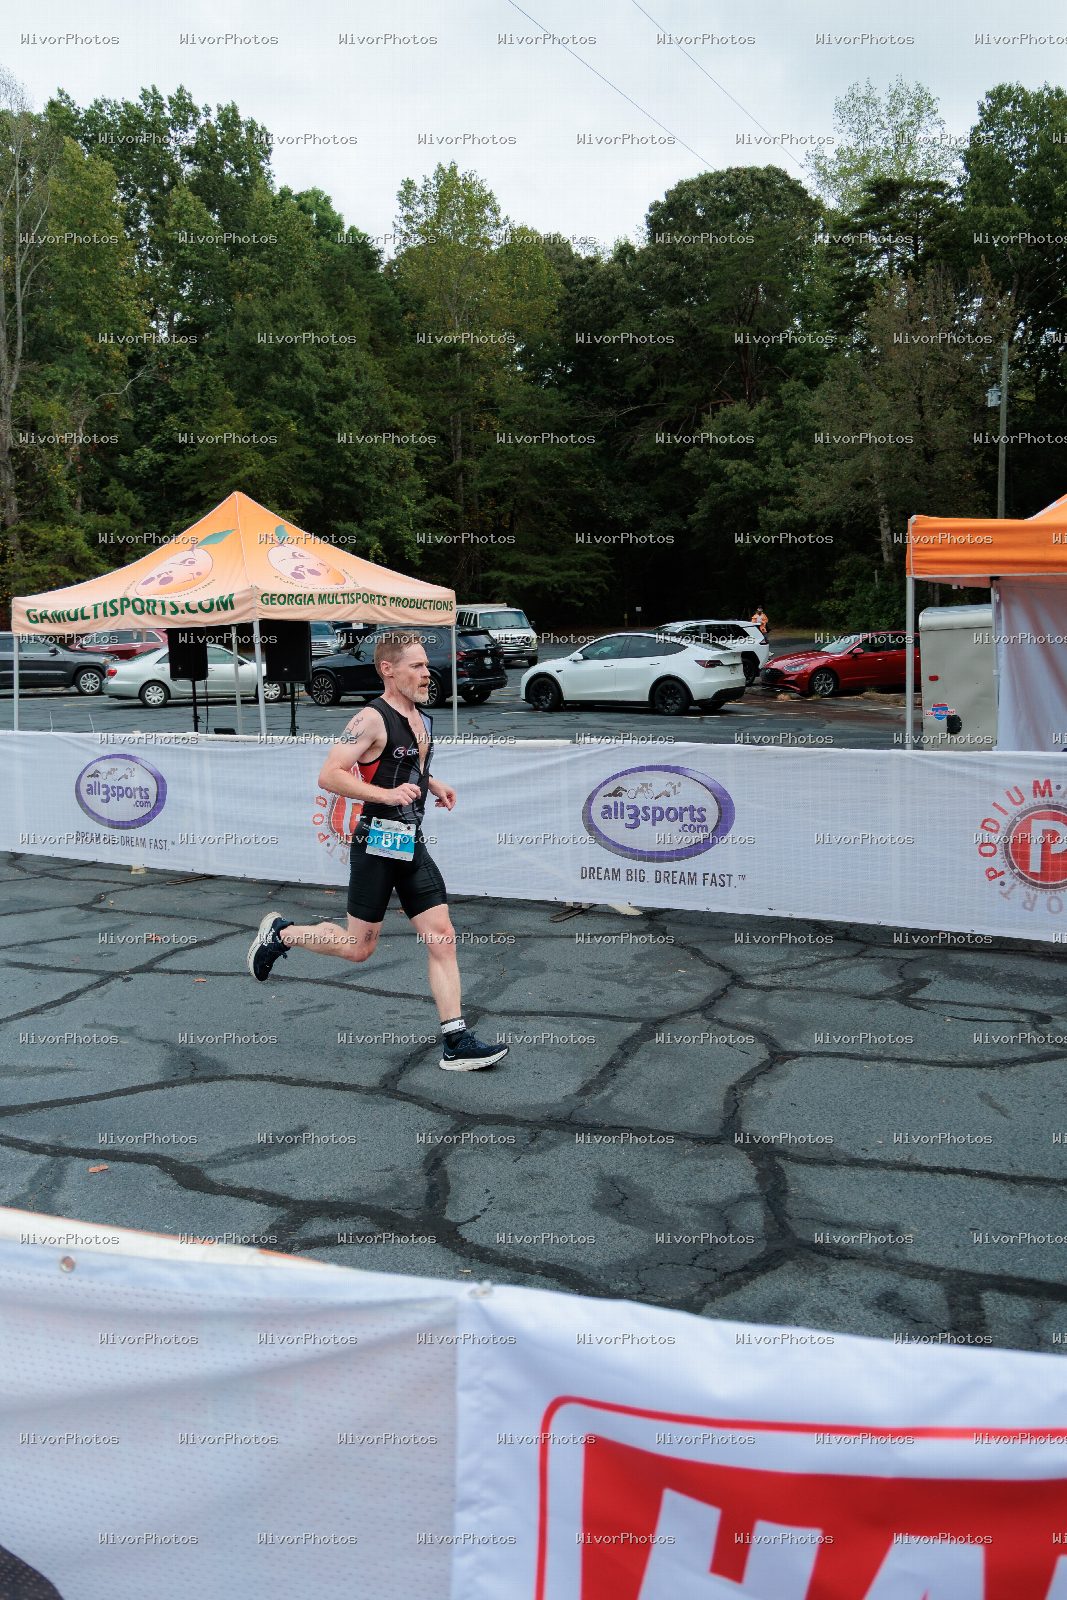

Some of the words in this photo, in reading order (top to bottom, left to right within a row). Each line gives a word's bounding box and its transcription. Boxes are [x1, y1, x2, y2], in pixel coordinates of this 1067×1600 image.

[25, 592, 235, 625] GAMULTISPORTS.COM
[260, 592, 315, 607] GEORGIA
[317, 592, 387, 607] MULTISPORTS
[389, 596, 454, 612] PRODUCTIONS
[86, 781, 150, 804] all3sports
[600, 800, 707, 829] all3sports
[678, 823, 709, 834] .com
[121, 836, 147, 848] DREAM
[580, 866, 621, 882] DREAM
[626, 868, 650, 884] BIG.
[655, 870, 698, 886] DREAM
